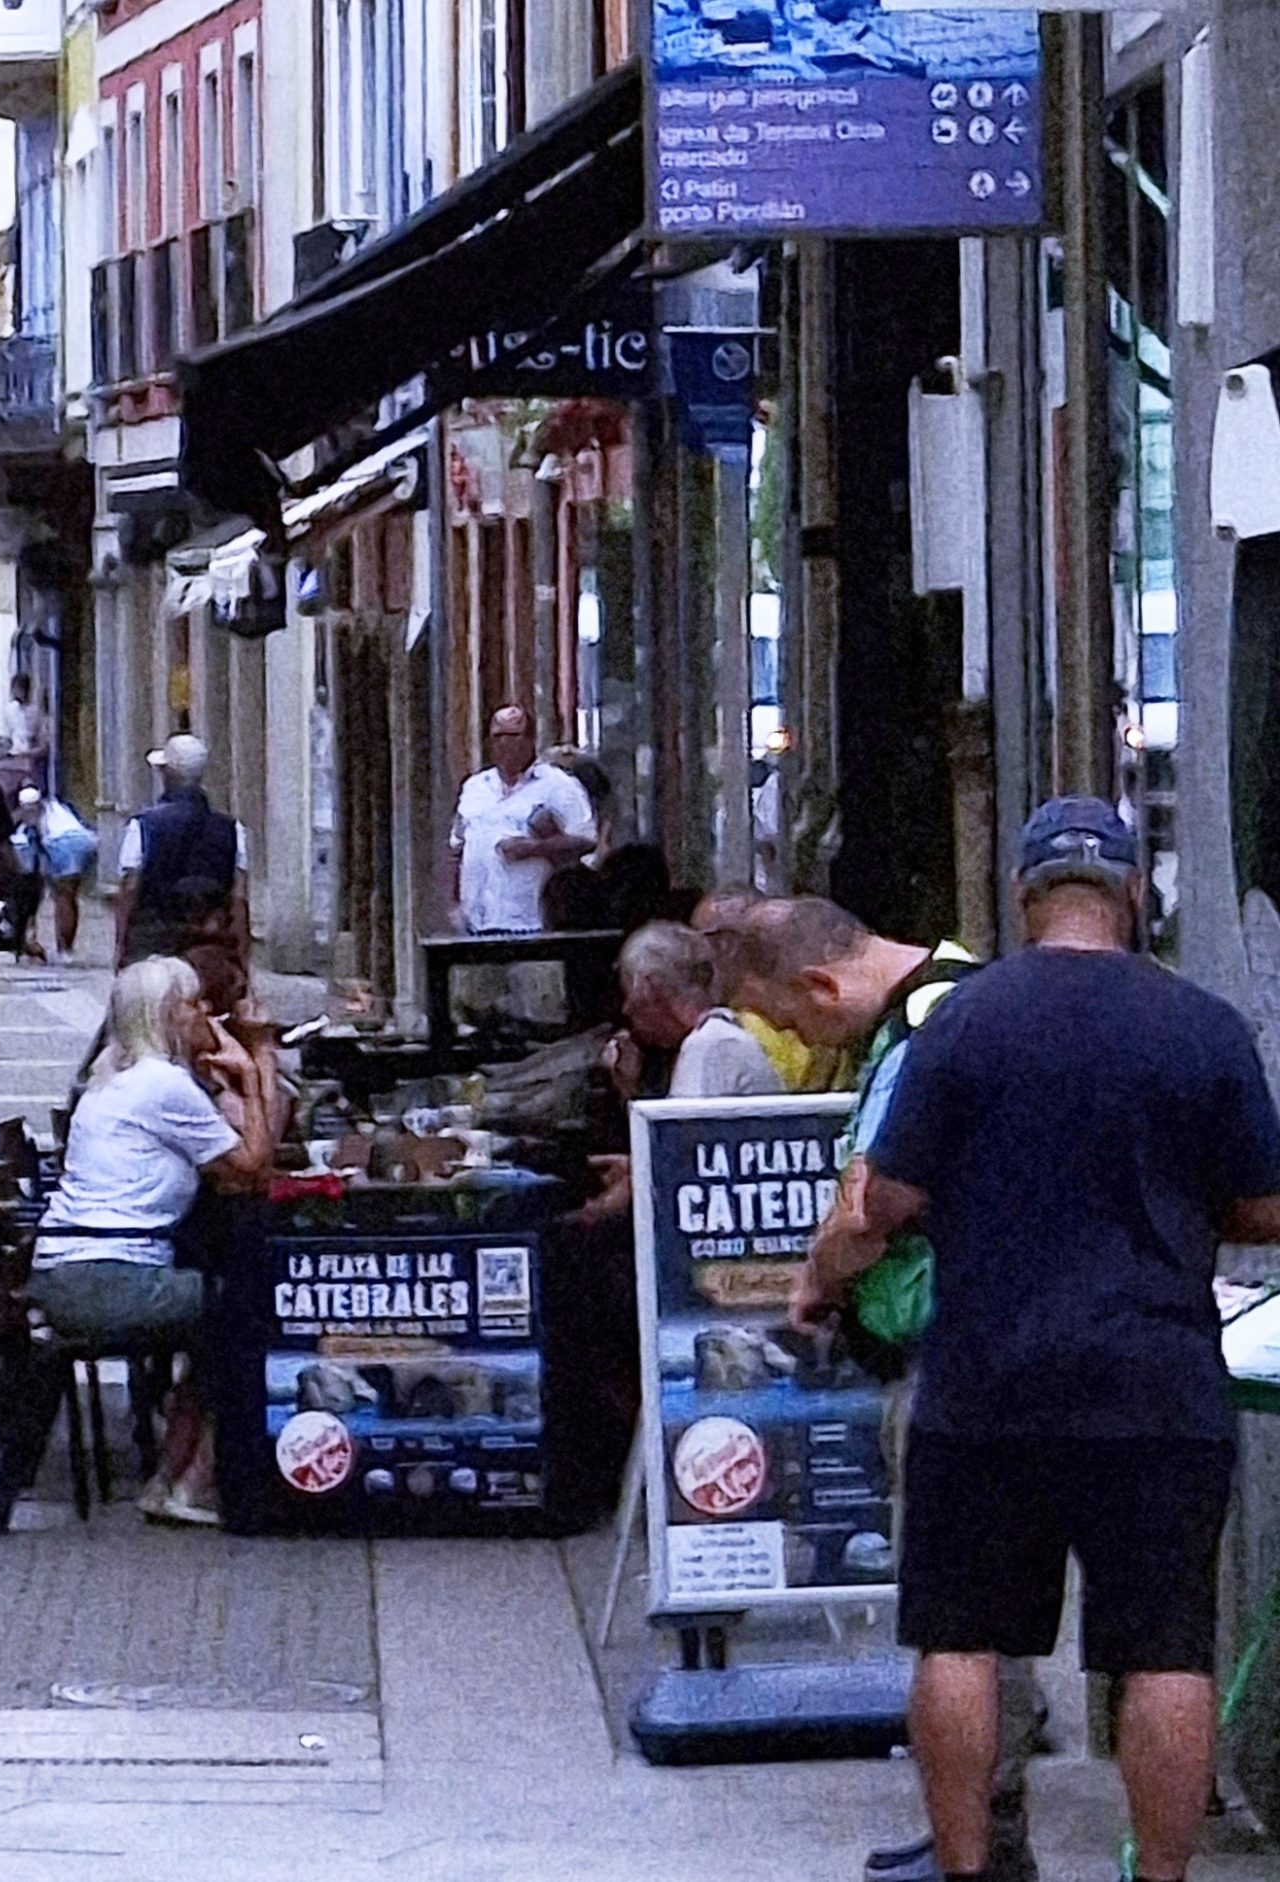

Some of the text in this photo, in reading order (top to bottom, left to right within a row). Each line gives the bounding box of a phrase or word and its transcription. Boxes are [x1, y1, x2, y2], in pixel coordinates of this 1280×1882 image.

[697, 1143, 729, 1178] LA
[739, 1140, 824, 1175] PLAYA
[289, 1254, 313, 1278] LA
[319, 1254, 381, 1278] PLAYA
[275, 1281, 469, 1318] CATEDRALES
